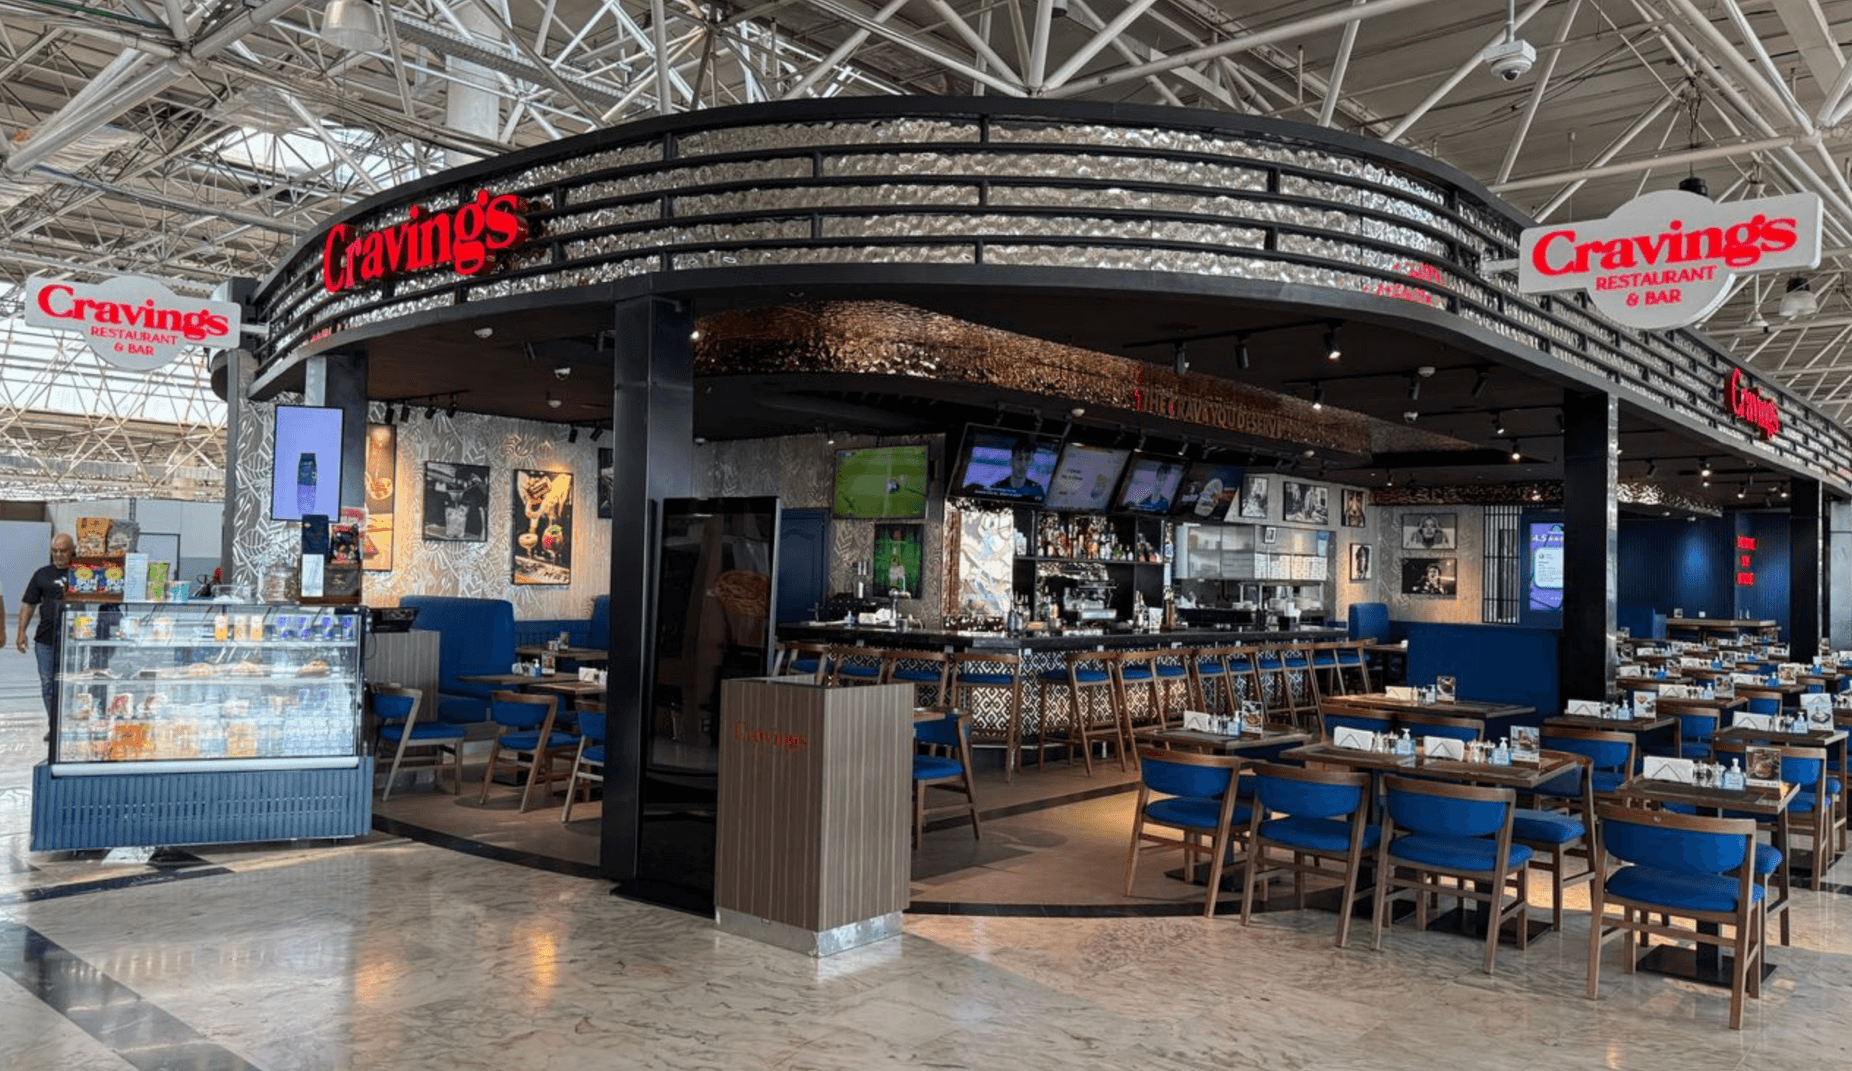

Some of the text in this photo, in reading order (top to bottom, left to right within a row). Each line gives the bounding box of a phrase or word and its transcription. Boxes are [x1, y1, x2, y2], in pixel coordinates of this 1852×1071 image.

[323, 189, 518, 293] Cravings
[1532, 214, 1797, 277] Cravings
[1595, 265, 1717, 292] RESTAURANT
[1626, 289, 1682, 307] & BAR
[37, 284, 229, 341] Cravings
[91, 325, 178, 345] RESTAURANT
[114, 342, 154, 356] & BAR
